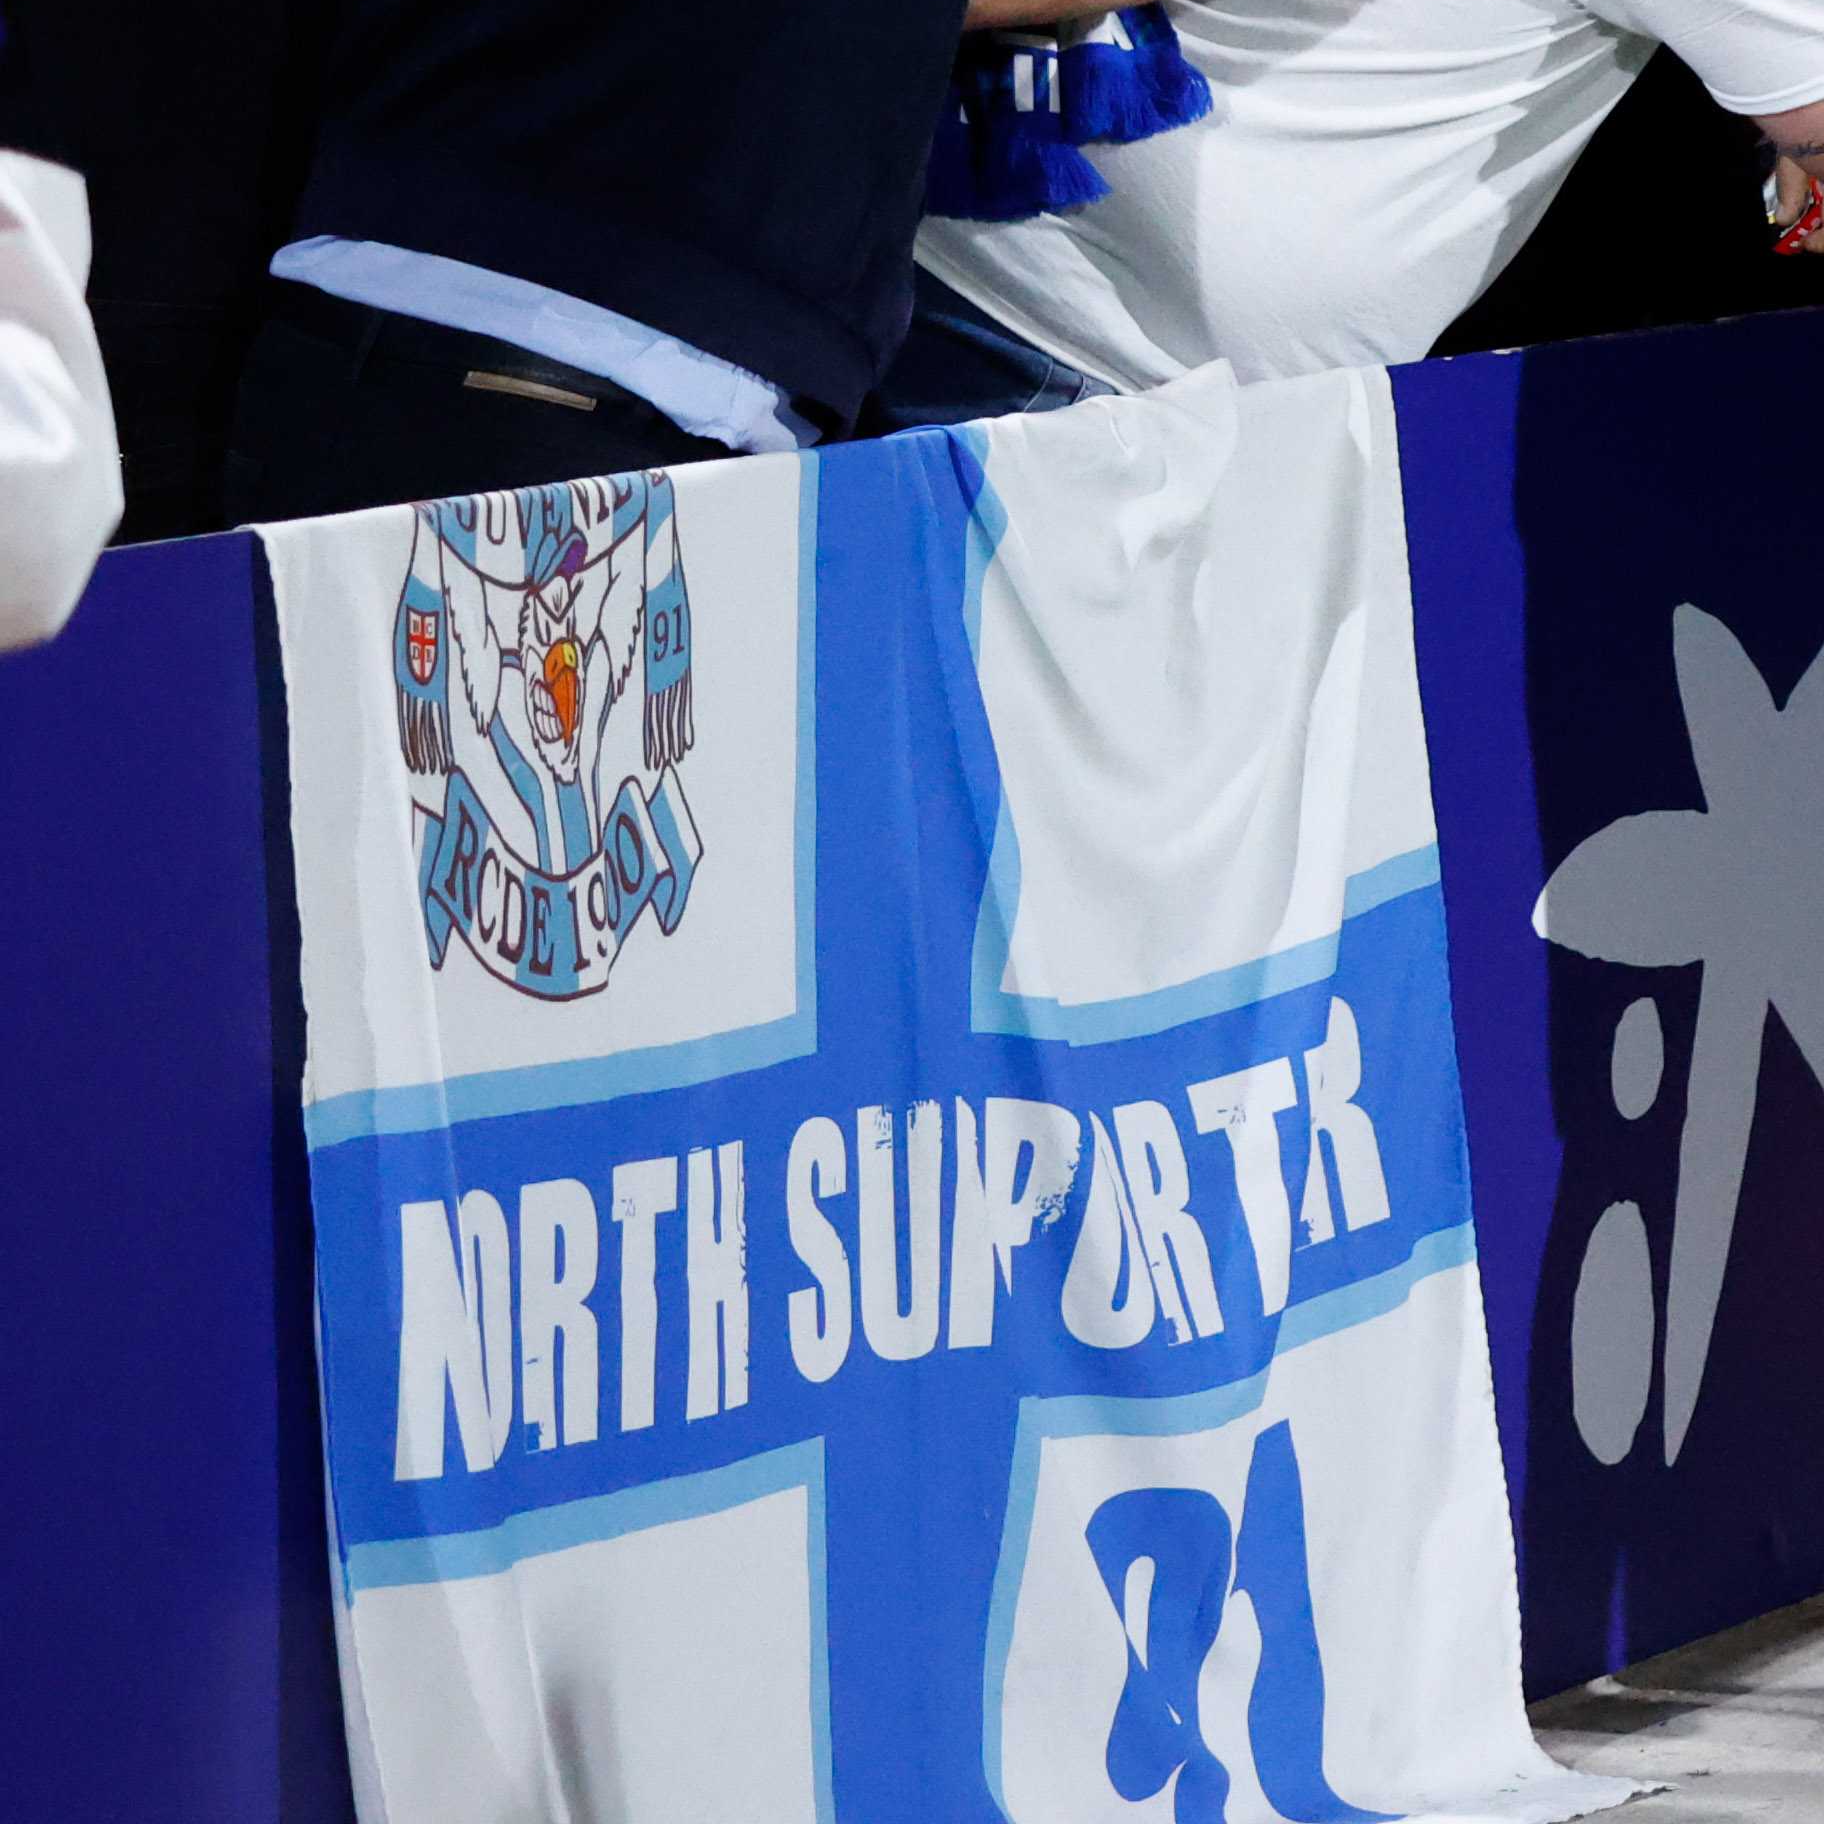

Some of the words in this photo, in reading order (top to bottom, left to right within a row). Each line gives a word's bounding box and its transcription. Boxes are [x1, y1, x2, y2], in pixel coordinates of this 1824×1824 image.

[652, 603, 686, 663] 91
[444, 799, 555, 976] RCDE
[394, 1140, 750, 1482] NORTH
